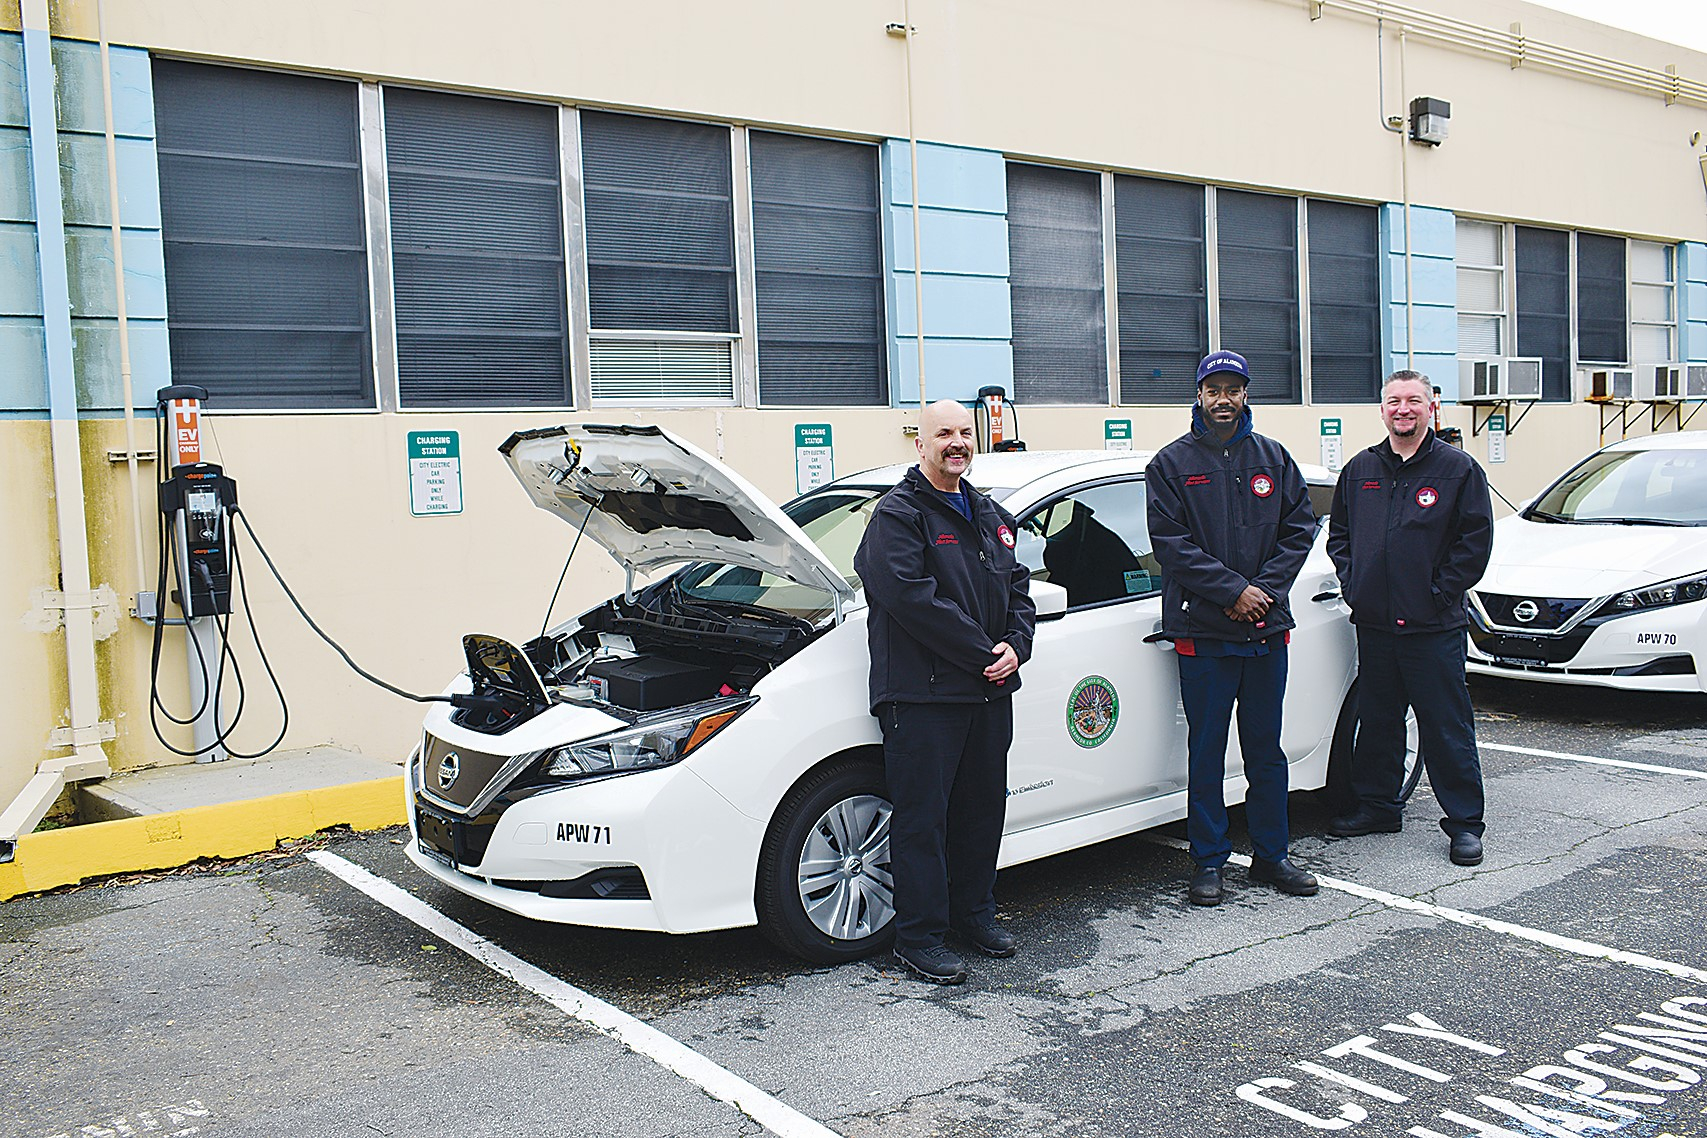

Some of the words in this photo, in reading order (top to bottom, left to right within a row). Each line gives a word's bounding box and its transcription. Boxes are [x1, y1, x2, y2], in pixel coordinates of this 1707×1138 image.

[991, 416, 1002, 426] EV
[178, 428, 198, 441] EV
[416, 436, 451, 444] CHARGING
[179, 445, 199, 453] ONLY
[421, 447, 447, 455] STATION
[419, 461, 430, 469] CITY
[1637, 633, 1662, 644] APW
[1664, 633, 1677, 645] 70
[556, 822, 590, 843] APW
[593, 825, 611, 845] 71
[1235, 1011, 1507, 1131] CITY
